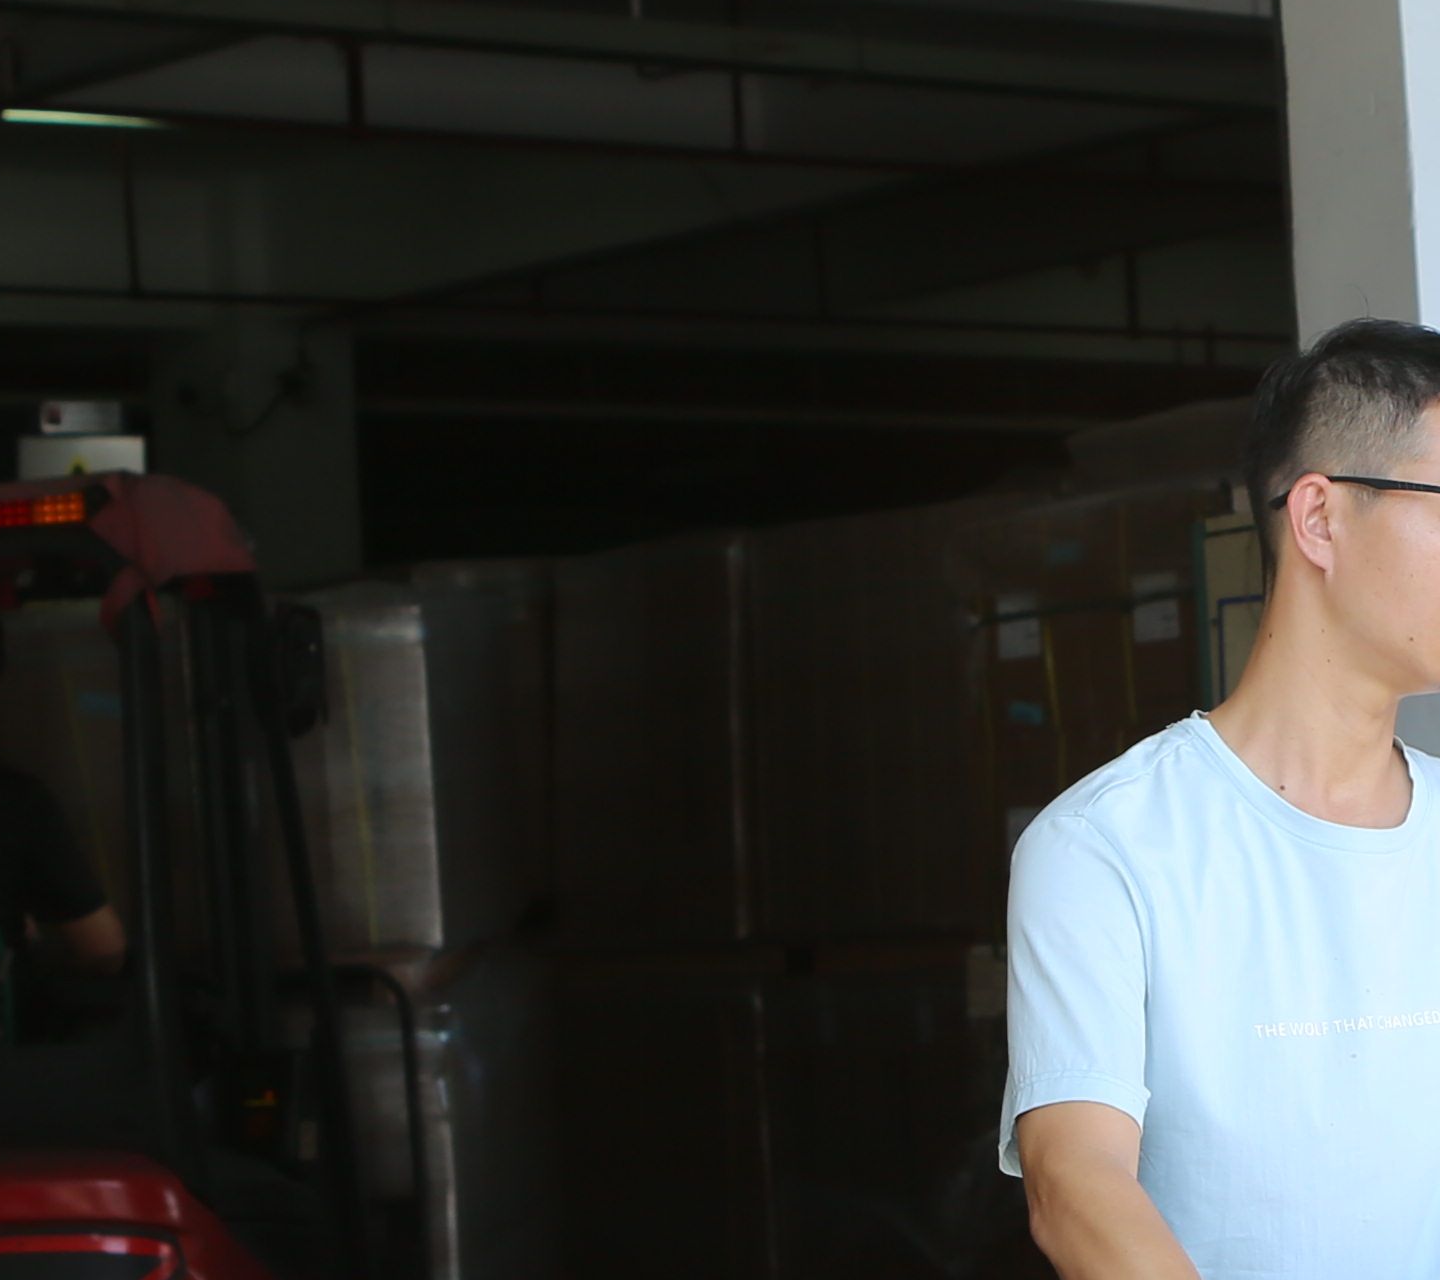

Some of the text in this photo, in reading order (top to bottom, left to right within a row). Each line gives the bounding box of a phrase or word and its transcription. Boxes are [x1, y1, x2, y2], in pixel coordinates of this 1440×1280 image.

[1254, 1023, 1287, 1039] THE
[1288, 1020, 1330, 1038] WOLF
[1333, 1015, 1377, 1035] THAT
